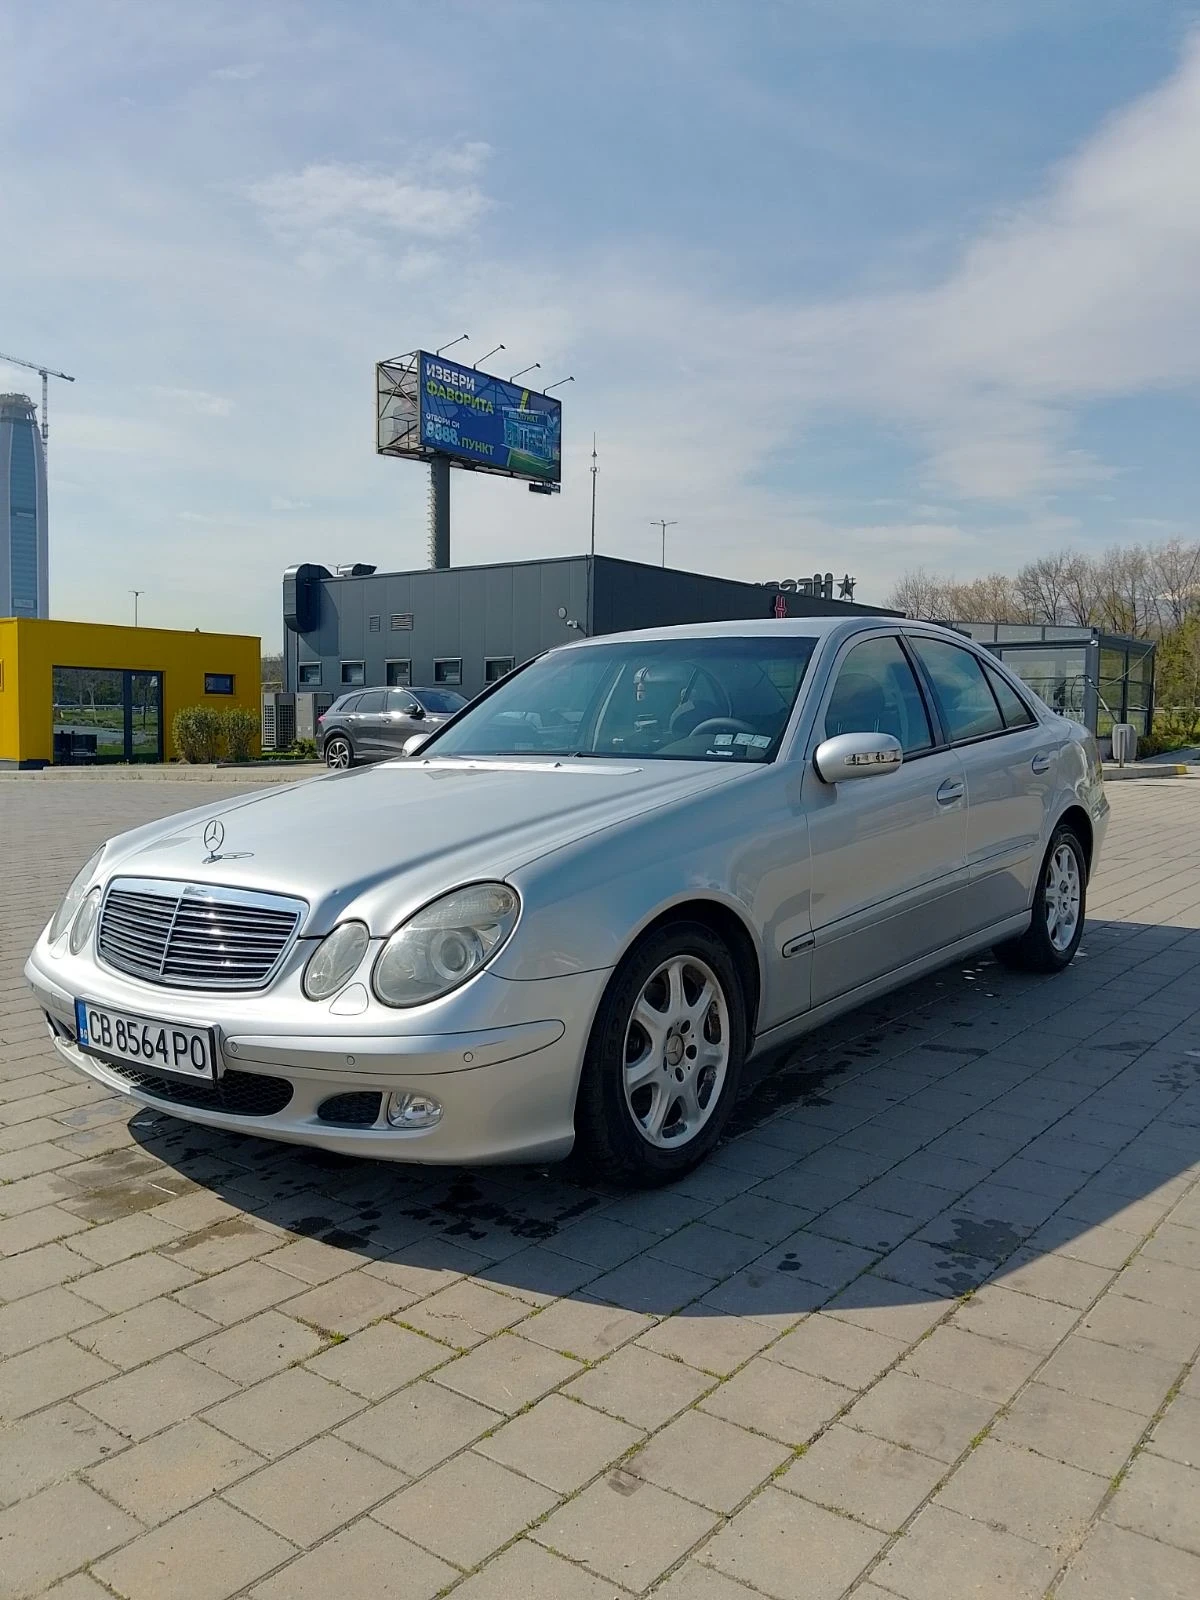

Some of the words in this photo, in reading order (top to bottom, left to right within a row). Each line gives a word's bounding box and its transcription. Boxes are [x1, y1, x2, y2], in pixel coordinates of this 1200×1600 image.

[426, 362, 475, 392] ИЗБЕРИ
[426, 380, 494, 415] ФАВОРИТА
[461, 436, 495, 456] ПУНКТ
